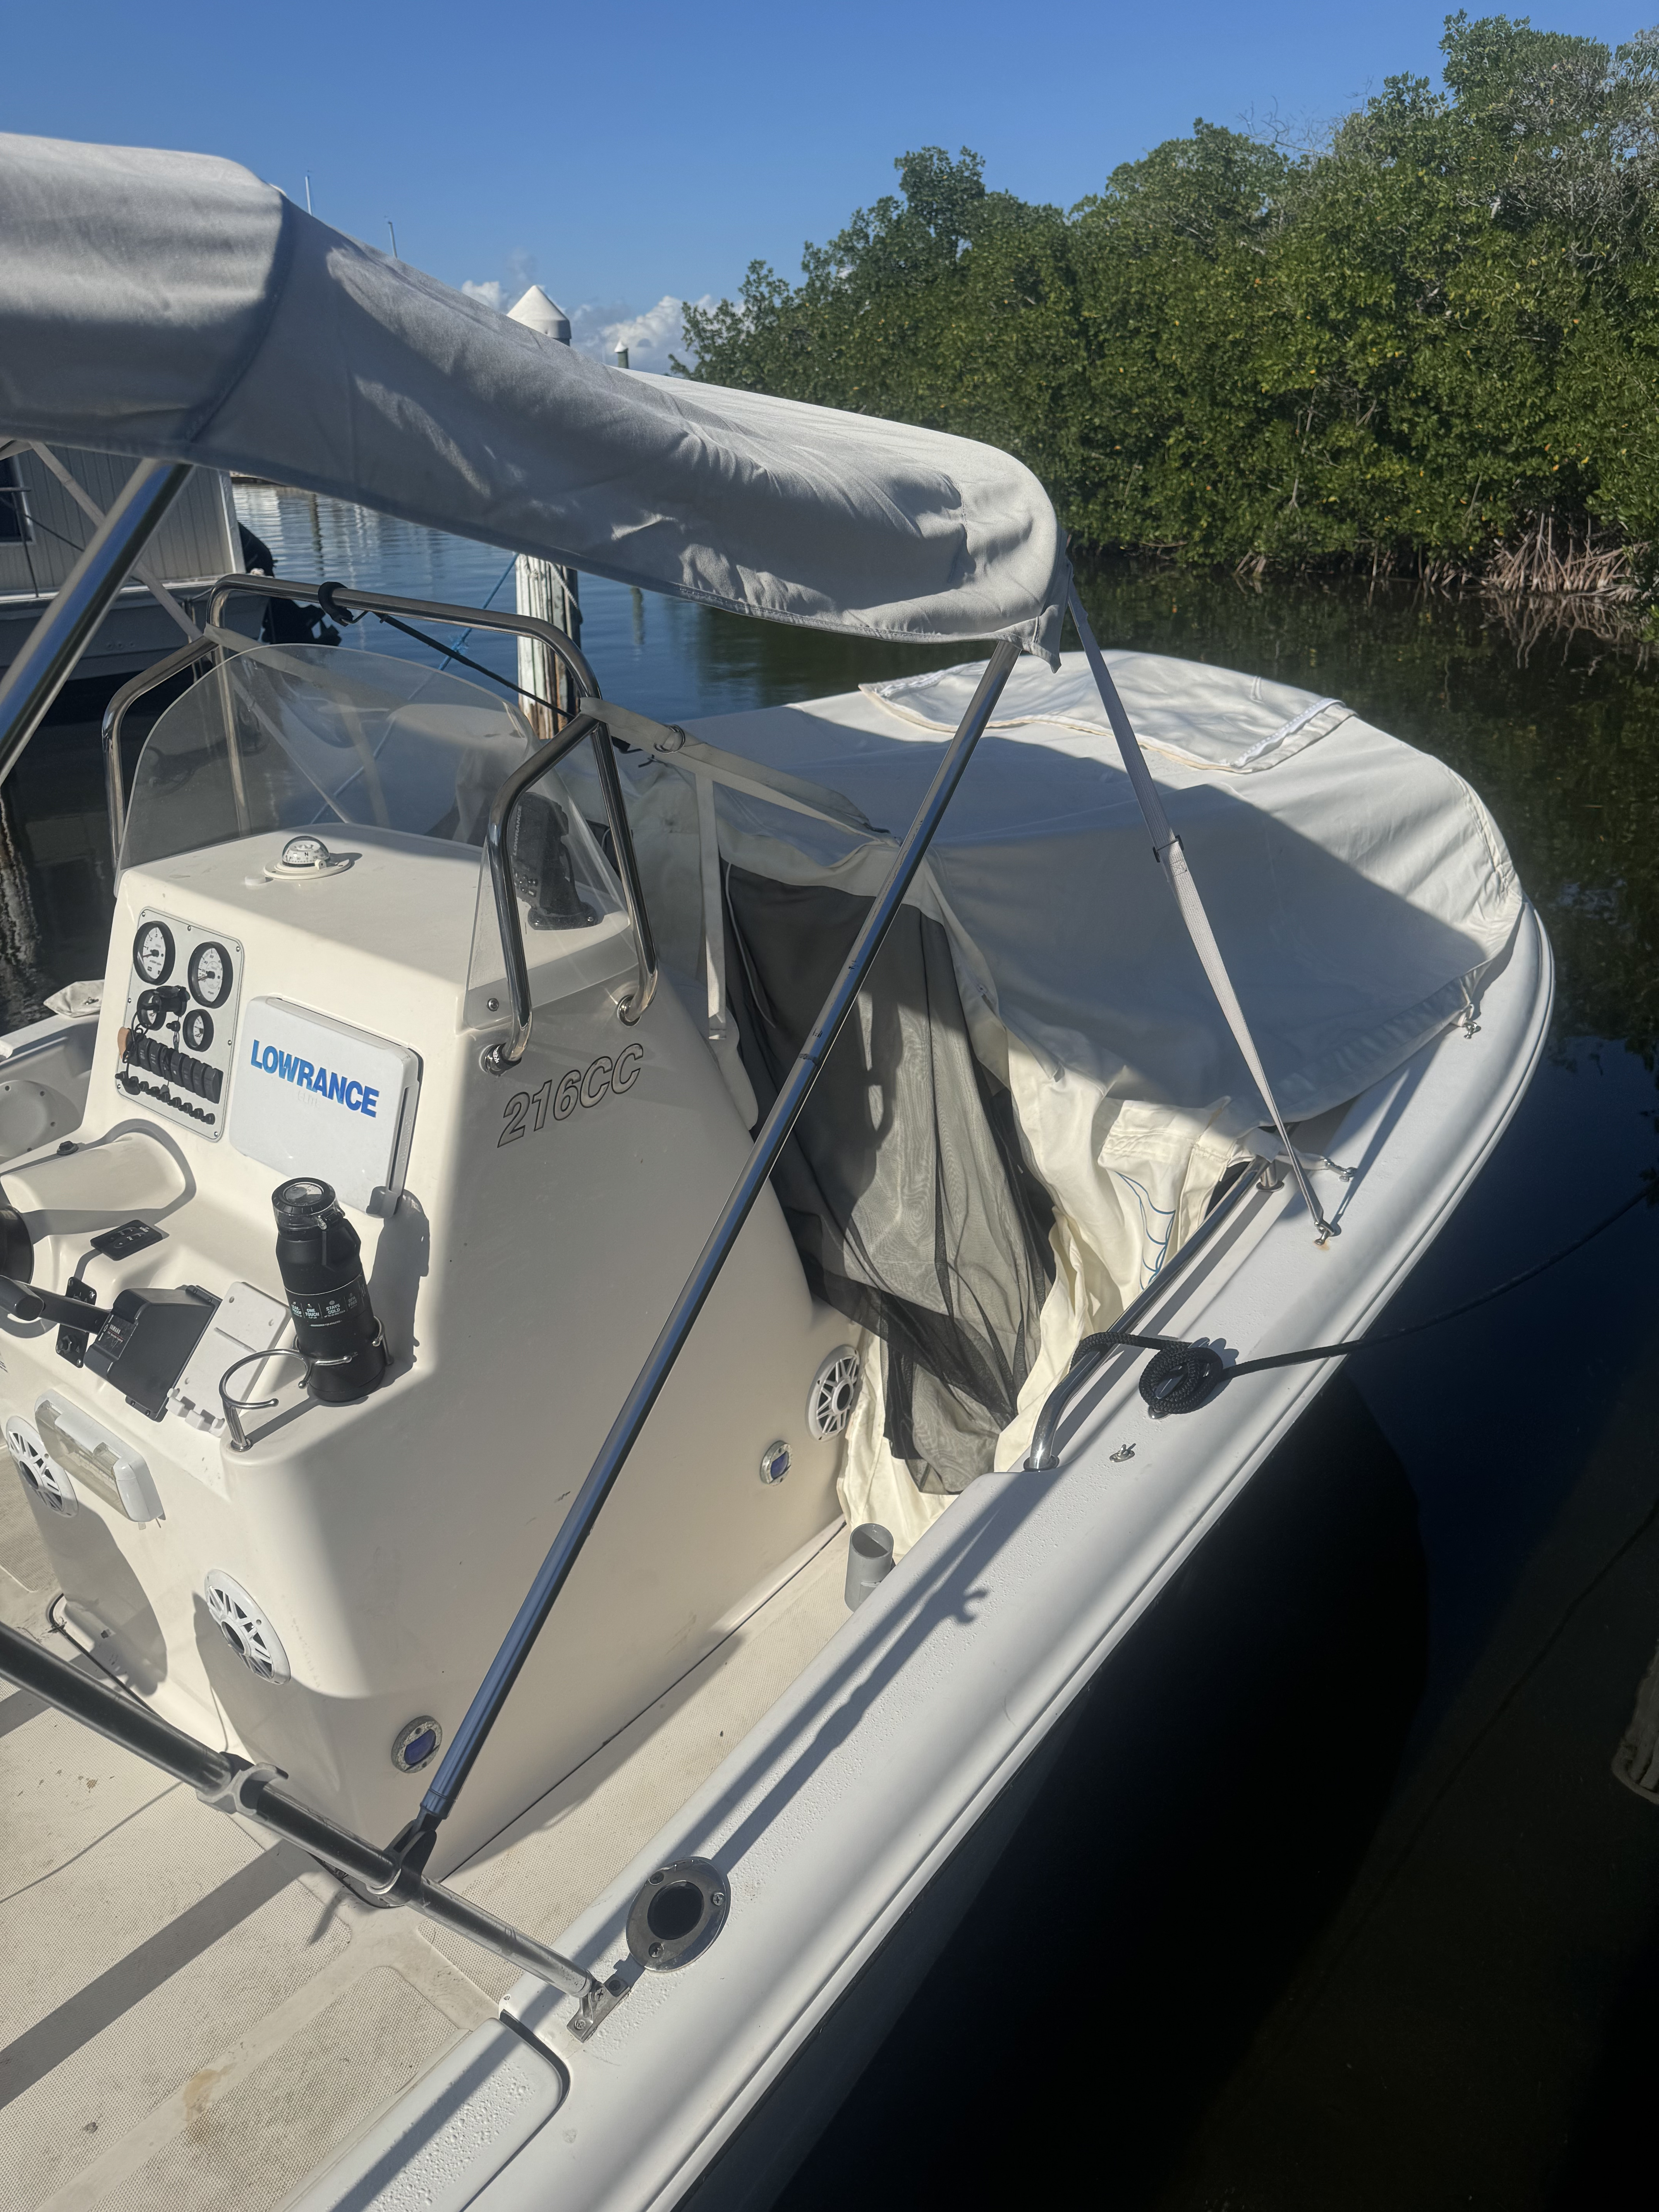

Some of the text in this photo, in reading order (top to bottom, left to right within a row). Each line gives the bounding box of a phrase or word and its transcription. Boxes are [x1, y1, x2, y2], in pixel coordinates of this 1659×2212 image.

[513, 805, 522, 856] LOWRANCE
[251, 1039, 380, 1118] LOWRANCE
[497, 1043, 644, 1148] 216CC
